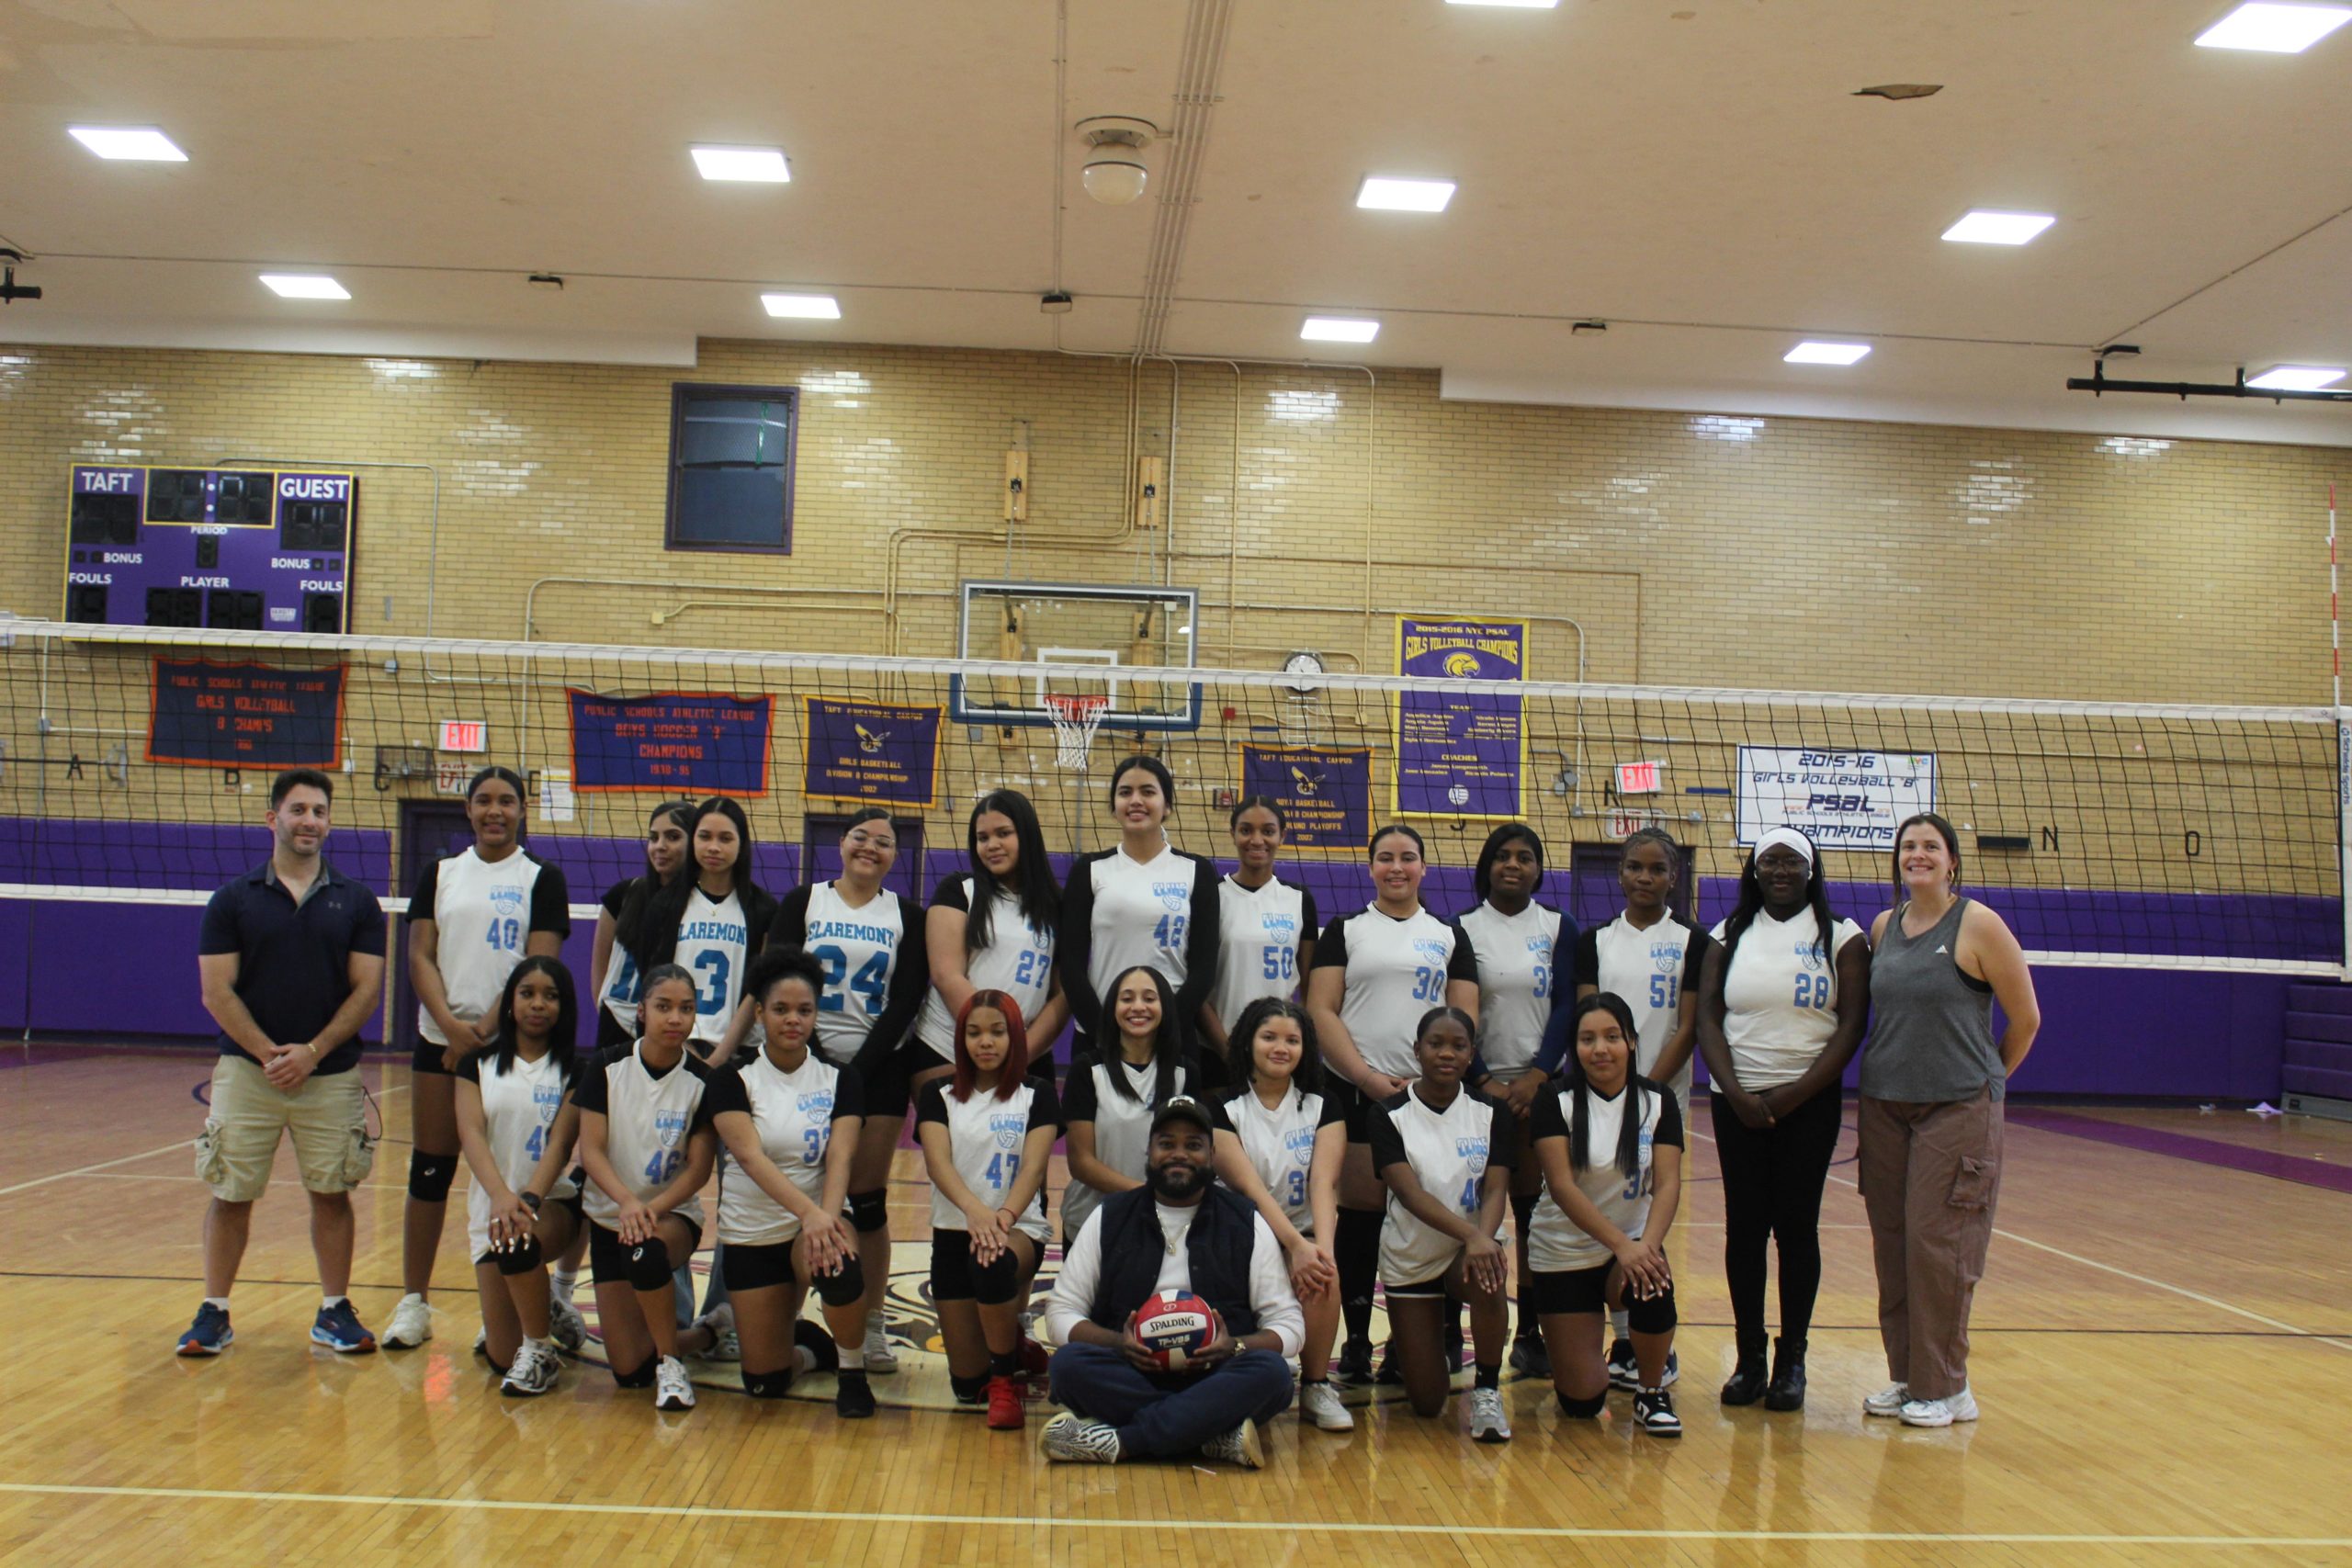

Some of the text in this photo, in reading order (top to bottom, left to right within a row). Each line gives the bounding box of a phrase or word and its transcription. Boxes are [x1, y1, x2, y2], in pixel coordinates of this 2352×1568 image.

[82, 472, 133, 492] TAFT
[280, 479, 348, 499] GUEST
[191, 525, 227, 535] PERIOD
[104, 553, 142, 564] BONUS
[271, 558, 310, 569] BONUS
[69, 572, 112, 584] FOULS
[181, 576, 230, 589] PLAYER
[300, 580, 343, 592] FOULS
[1406, 637, 1518, 665] GIRLS VOLLEYBALL CHAMPIONS
[196, 695, 296, 713] GIRLS VOLLEYBALL
[584, 705, 755, 721] PUBLIC SCHOOLS ATHLETIC LEAGUE
[447, 722, 480, 750] EXIT
[616, 724, 646, 738] BOYS
[639, 744, 703, 760] CHAMPIONS
[1798, 753, 1875, 768] 2015-16
[66, 754, 83, 780] A
[1623, 763, 1656, 790] EXIT
[1806, 794, 1875, 812] PSAL
[2042, 826, 2058, 852] N
[486, 918, 519, 951] 40
[808, 920, 895, 949] CLAREMONT
[1015, 950, 1050, 989] 27
[1263, 946, 1294, 980] 50
[812, 944, 889, 1015] 24
[1412, 966, 1445, 1002] 30
[1650, 975, 1677, 1009] 51
[1793, 973, 1828, 1009] 28
[986, 1153, 1020, 1189] 47
[1149, 1316, 1194, 1333] SPALDING
